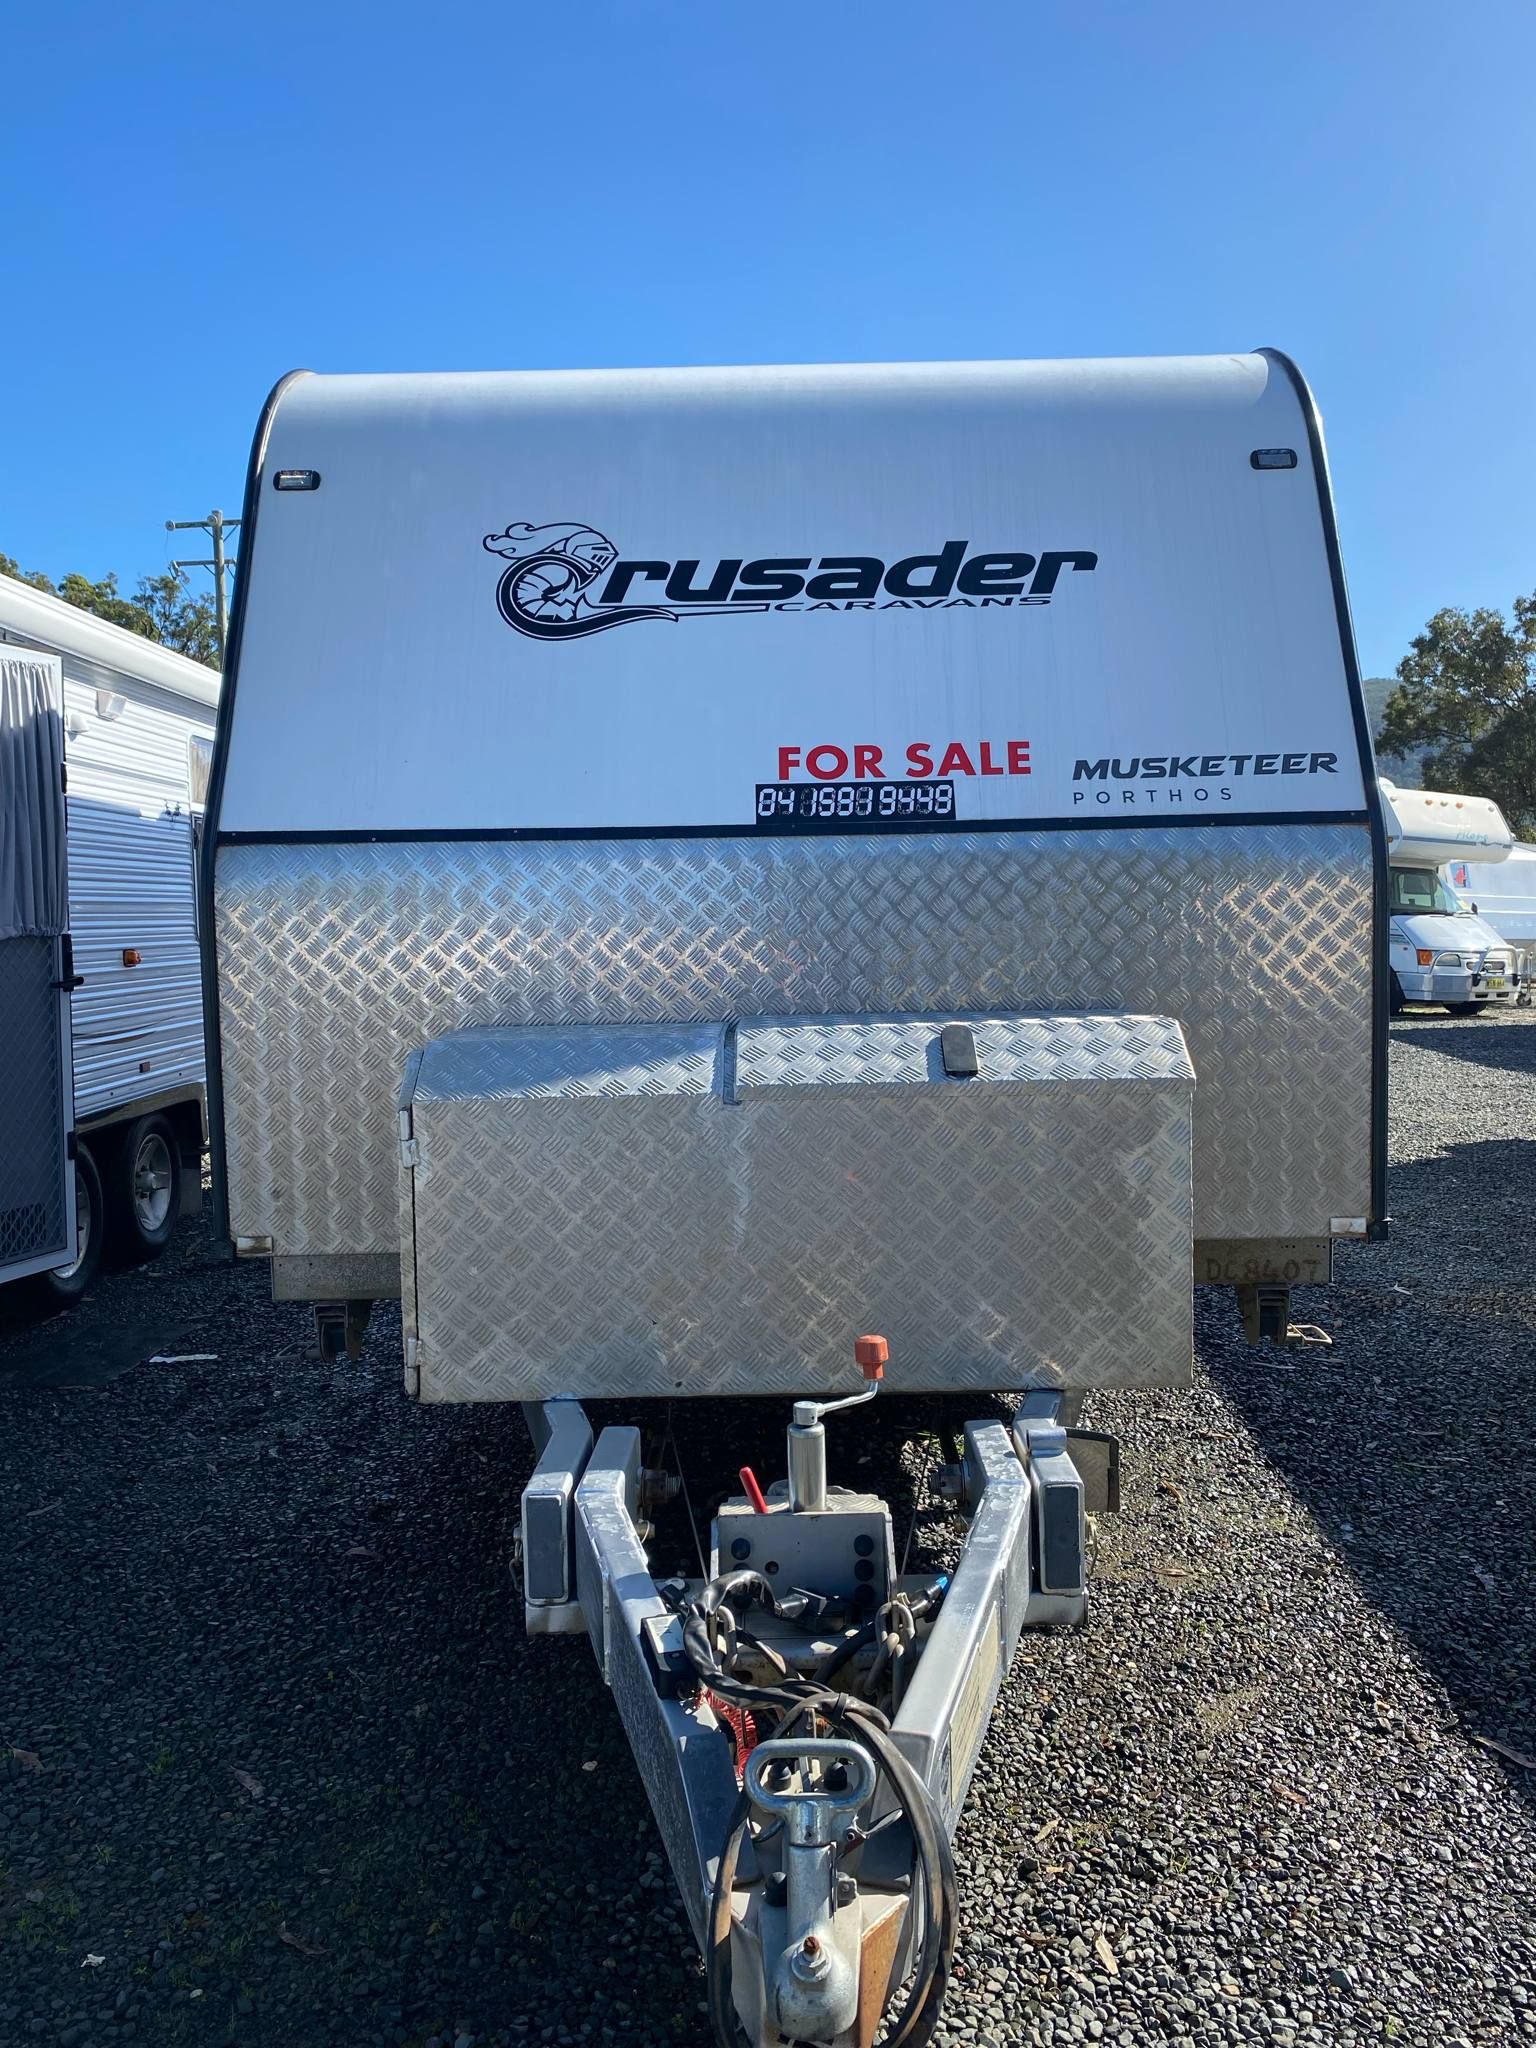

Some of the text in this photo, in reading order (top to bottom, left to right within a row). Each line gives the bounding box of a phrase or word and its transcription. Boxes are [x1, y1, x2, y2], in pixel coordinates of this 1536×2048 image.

[774, 595, 1052, 612] CARAVANS
[777, 740, 1032, 781] FOR SALE
[1071, 752, 1339, 781] MUSKETEER
[1073, 786, 1232, 805] PORTHOS
